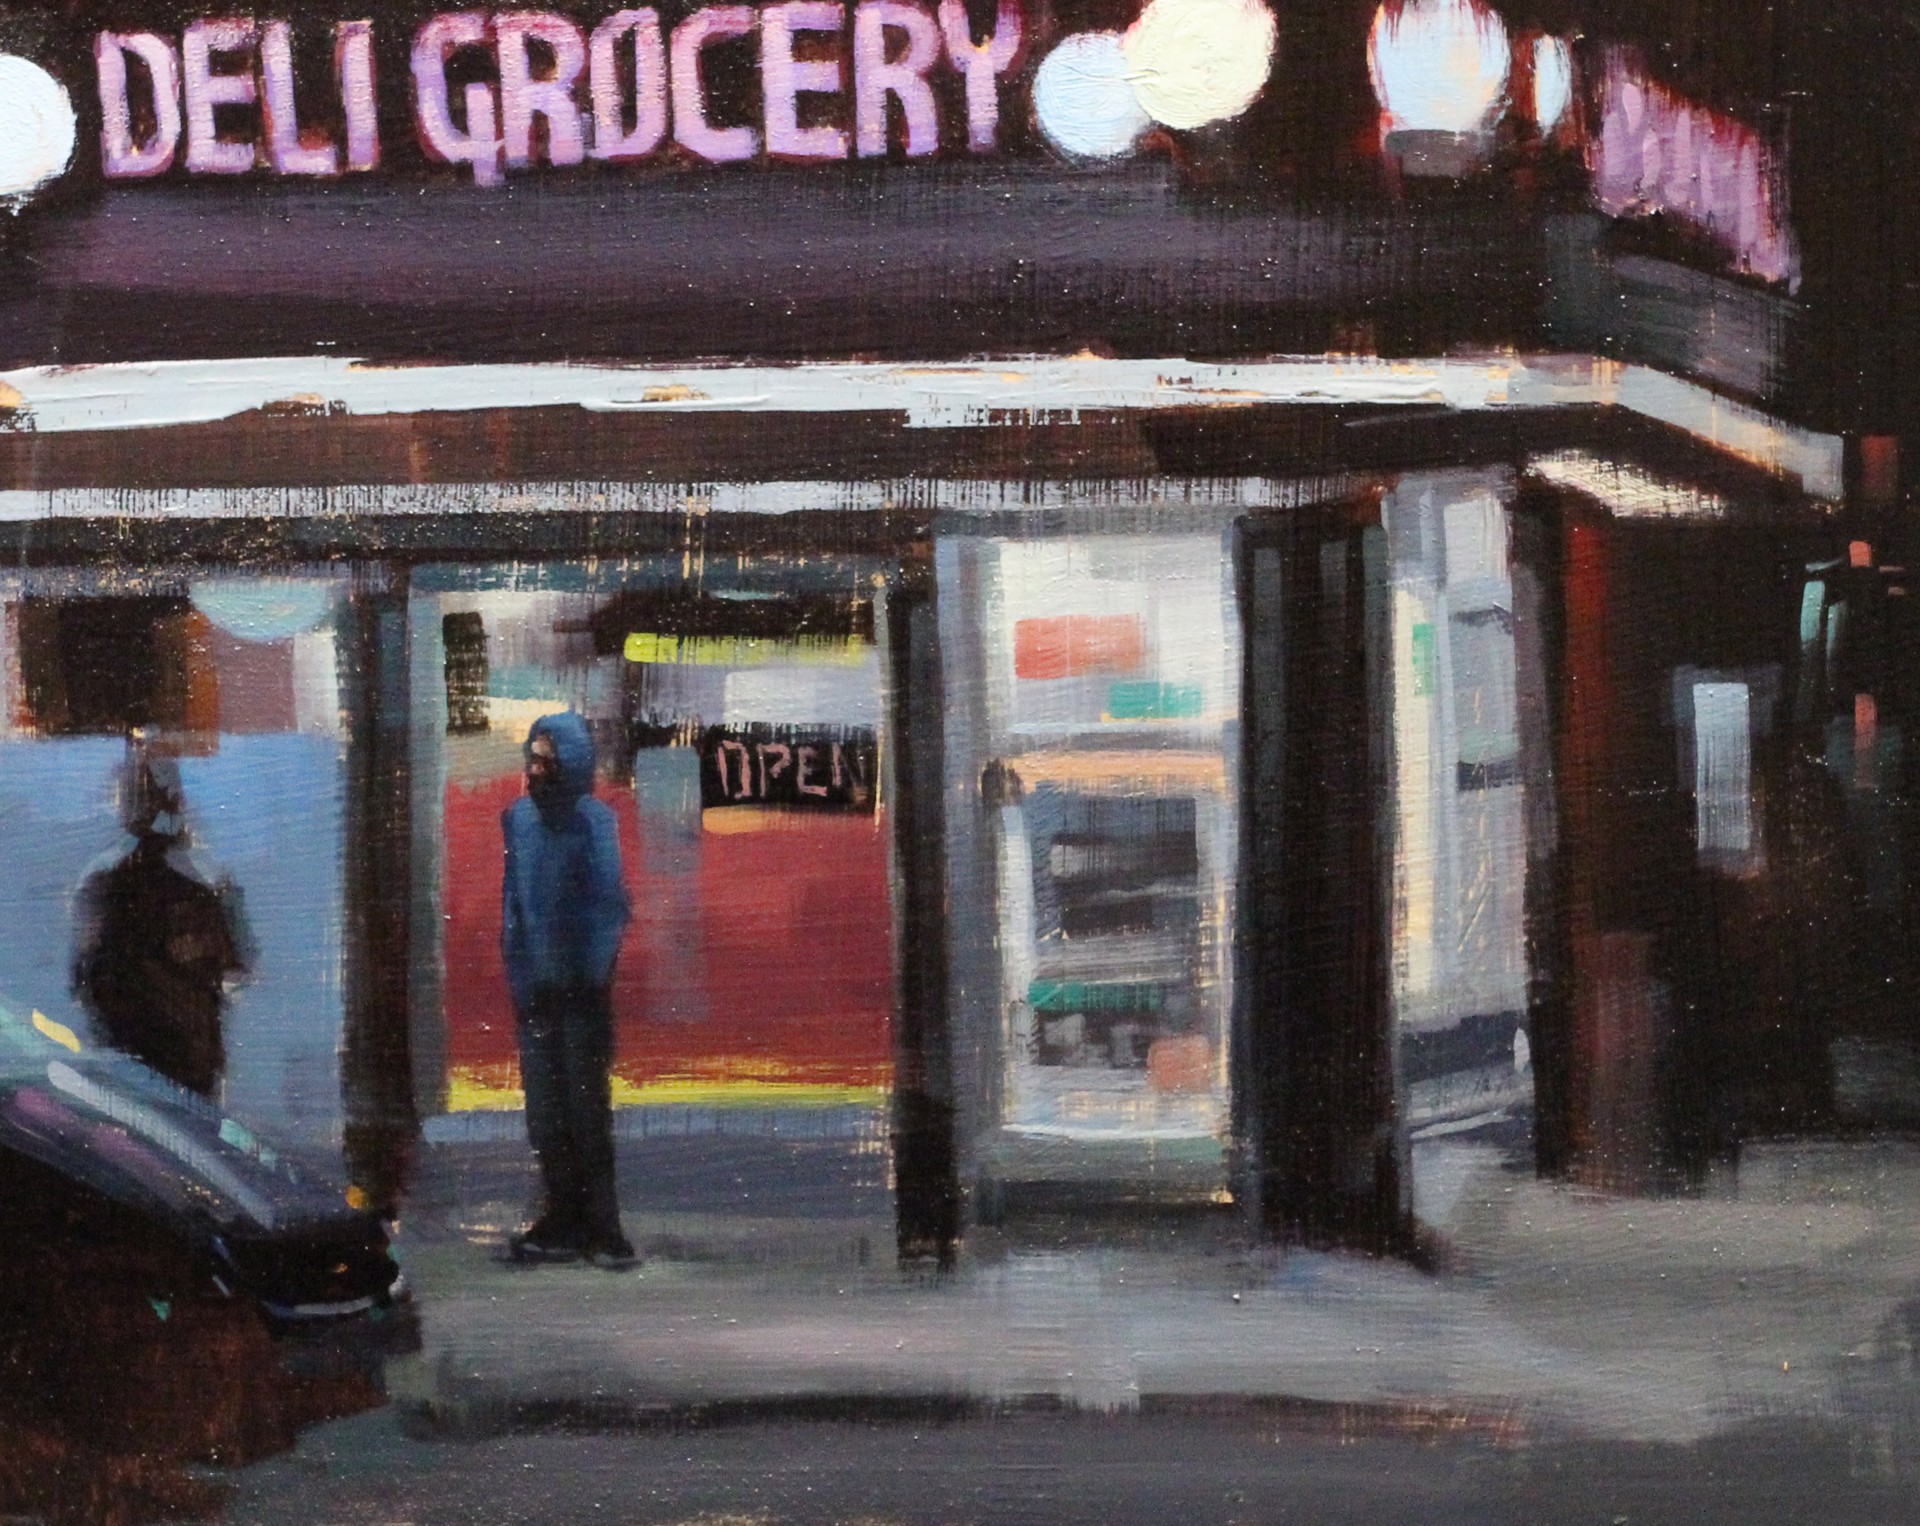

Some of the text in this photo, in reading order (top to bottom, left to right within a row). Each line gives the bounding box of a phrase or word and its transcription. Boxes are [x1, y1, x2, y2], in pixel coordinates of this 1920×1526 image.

[95, 0, 1024, 185] DELI GROCERY
[717, 739, 866, 799] OPEN
